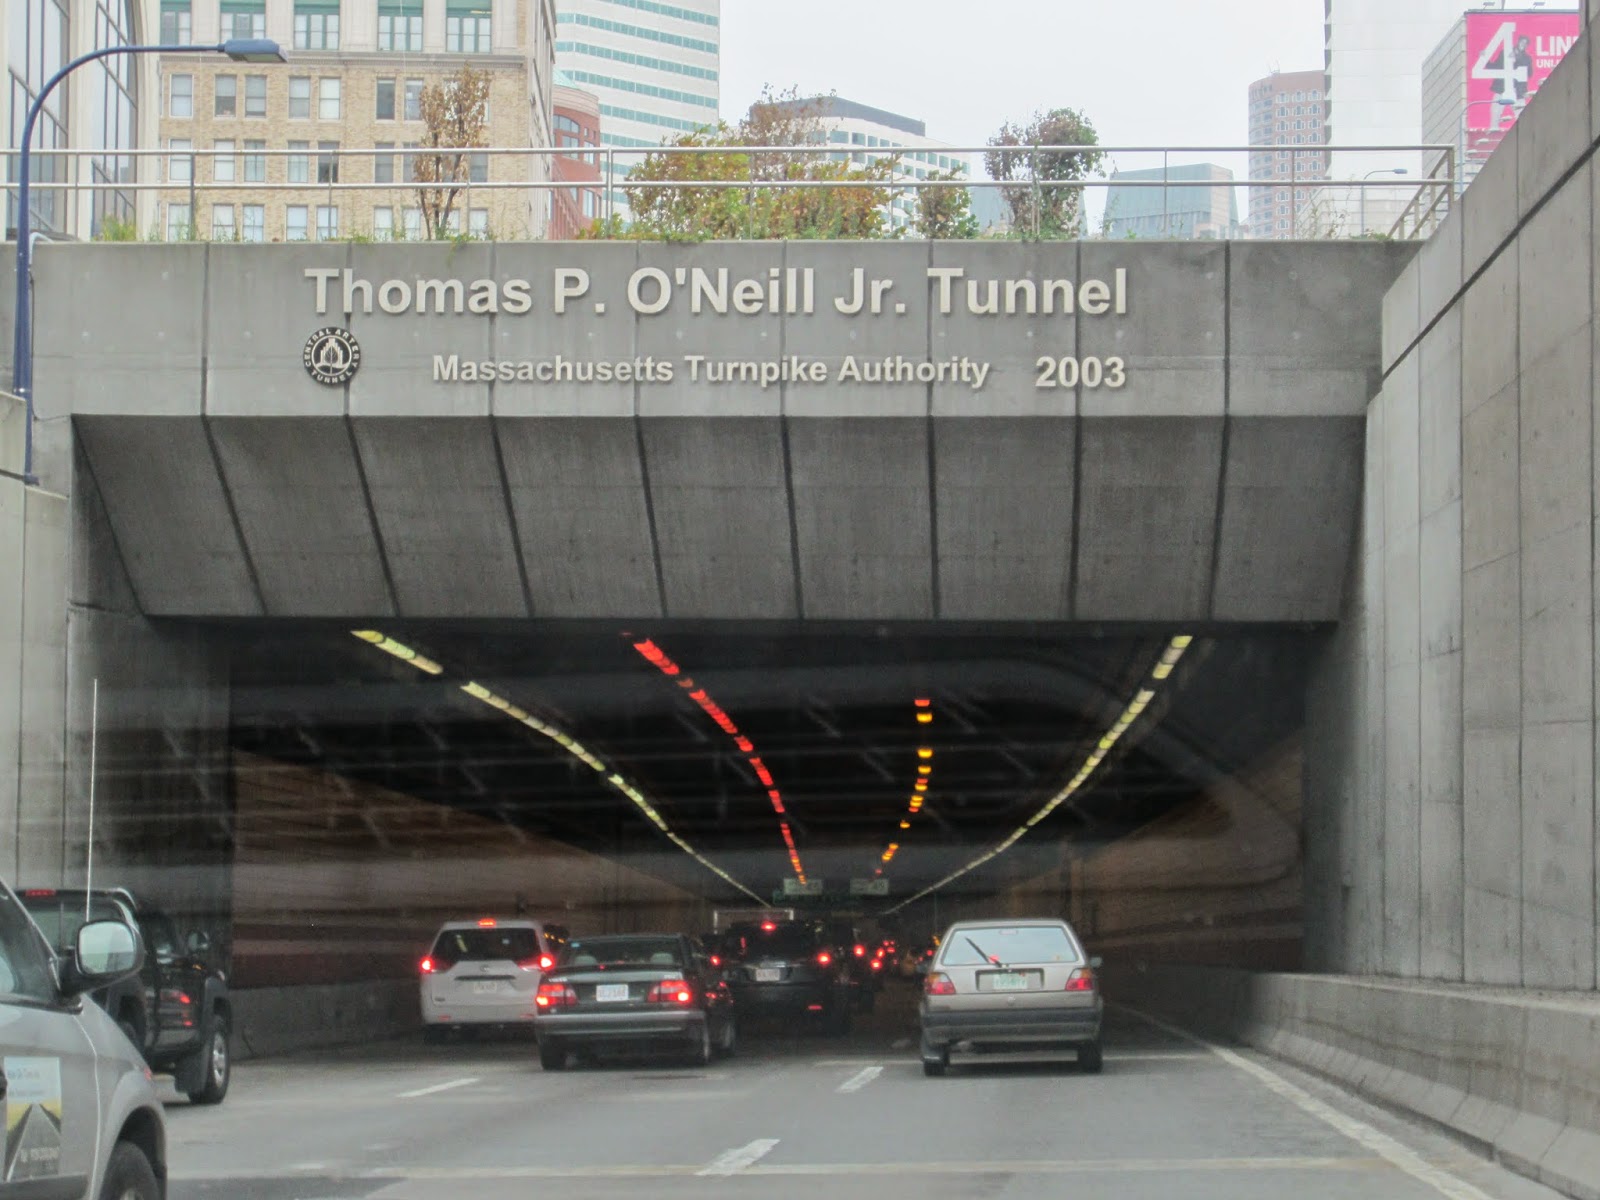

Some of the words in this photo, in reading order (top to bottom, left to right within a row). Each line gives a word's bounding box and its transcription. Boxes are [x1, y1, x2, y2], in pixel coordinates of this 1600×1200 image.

[1471, 22, 1528, 101] 4
[1536, 35, 1579, 56] LIN
[304, 268, 532, 314] Thomas
[554, 268, 605, 313] P.
[627, 267, 814, 314] O'Neill
[834, 267, 905, 314] Jr.
[927, 267, 1126, 314] Tunnel
[304, 328, 331, 367] CENTRAL
[335, 328, 360, 368] ARTERY
[311, 370, 353, 384] TUNNEL
[433, 354, 674, 382] Massachusetts
[684, 354, 827, 388] Turnpike
[837, 354, 989, 389] Authority
[1035, 356, 1126, 388] 2003
